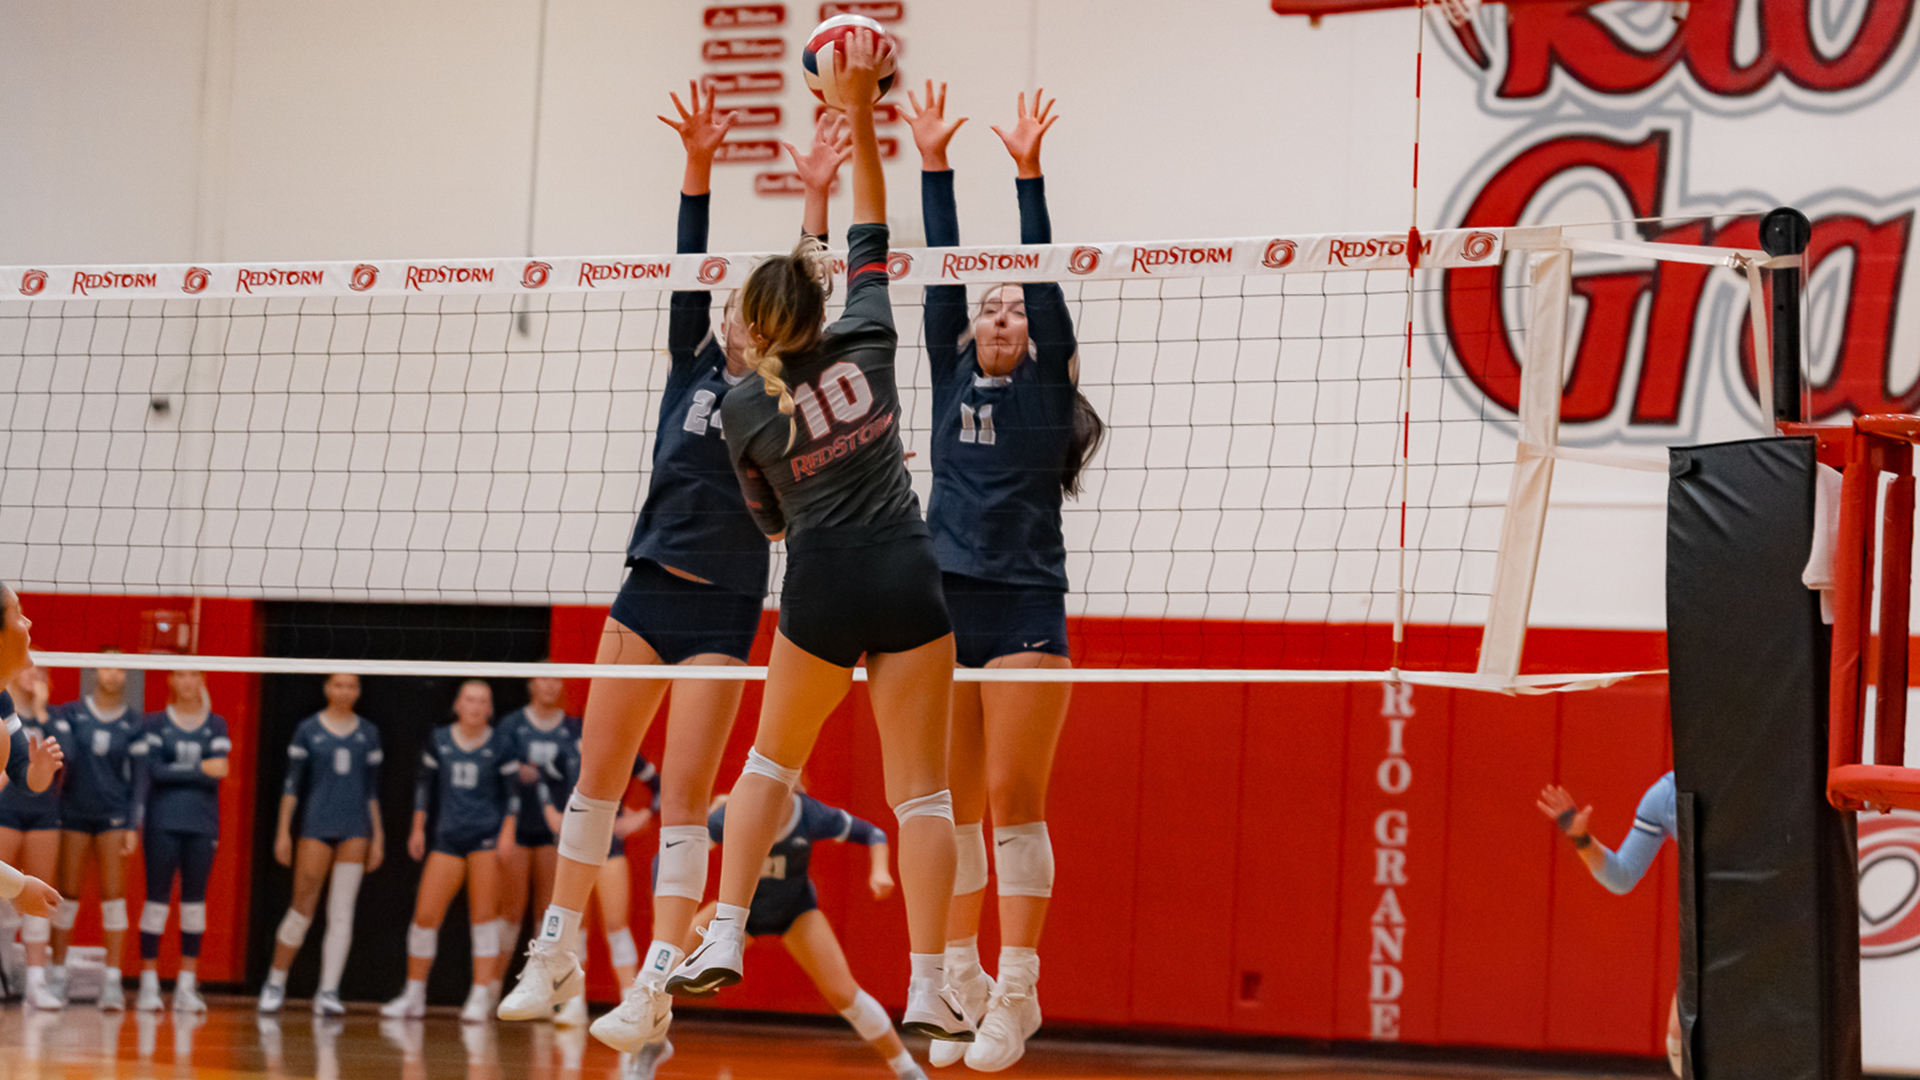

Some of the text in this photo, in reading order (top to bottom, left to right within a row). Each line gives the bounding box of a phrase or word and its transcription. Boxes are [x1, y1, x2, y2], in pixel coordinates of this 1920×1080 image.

[1327, 238, 1432, 267] REDSTOM
[793, 361, 873, 440] 10
[959, 402, 996, 445] 11
[1369, 682, 1415, 1041] RIO GRANDE
